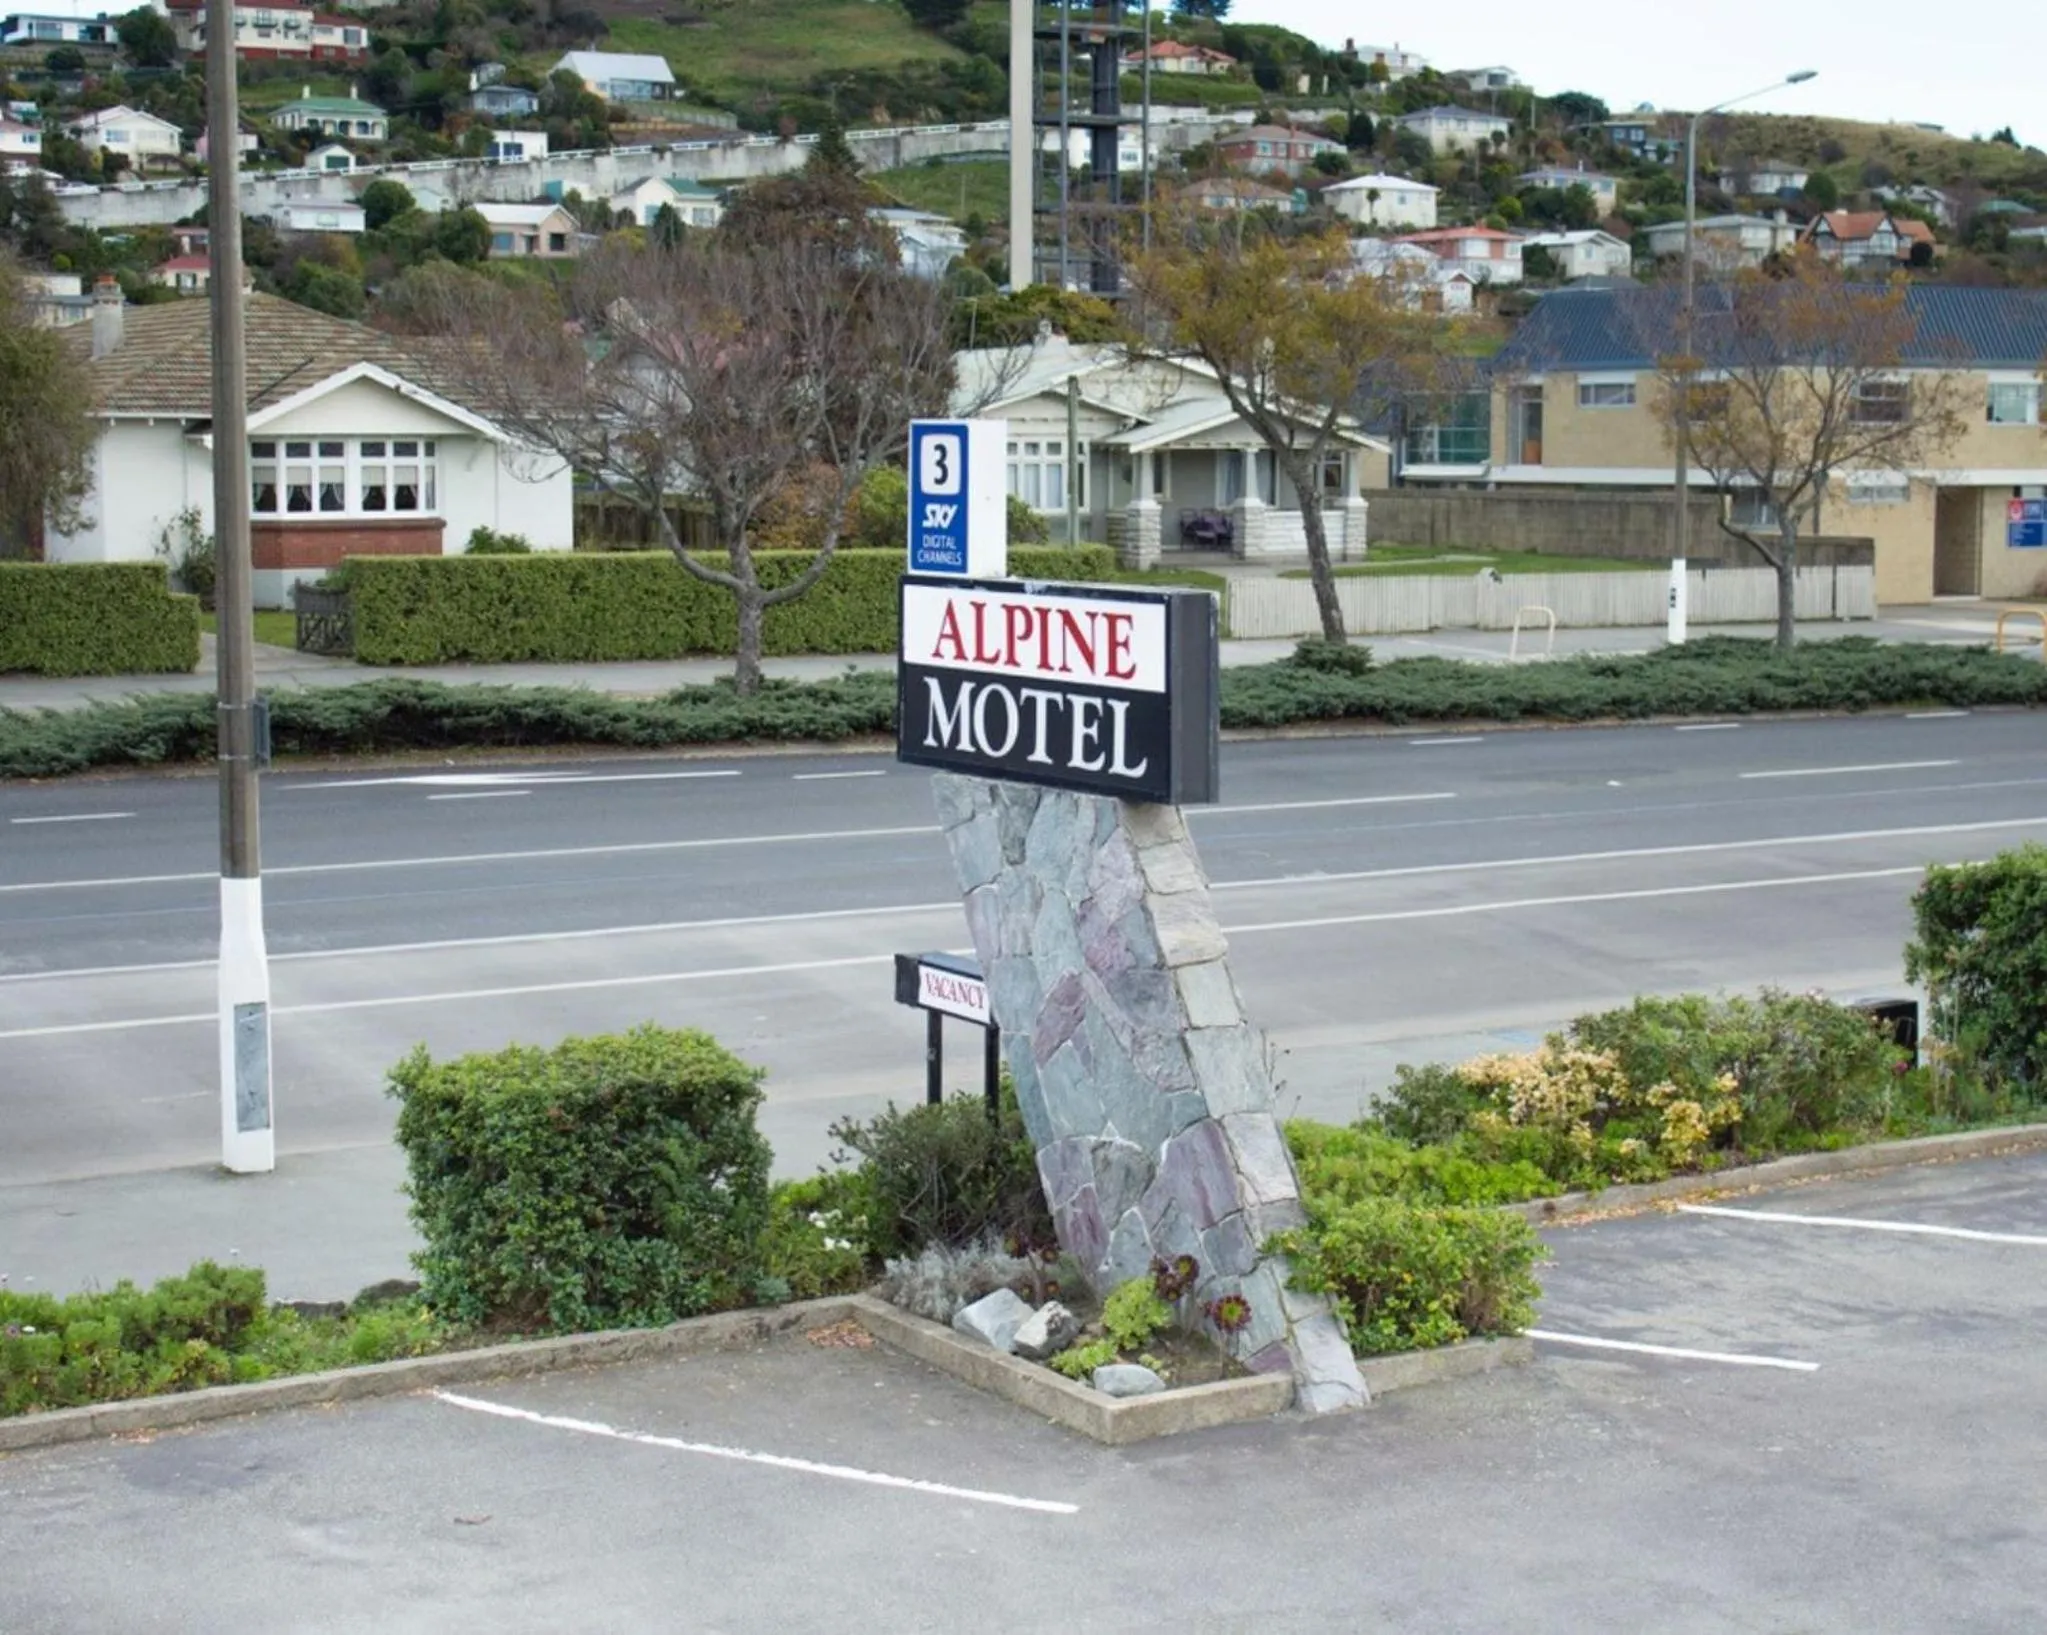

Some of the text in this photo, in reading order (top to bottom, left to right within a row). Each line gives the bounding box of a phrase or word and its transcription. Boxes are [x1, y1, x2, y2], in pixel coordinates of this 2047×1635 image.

[934, 444, 948, 485] 3
[922, 504, 958, 528] SKY
[916, 549, 962, 566] CHANNELS
[922, 534, 957, 550] DIGITAL
[933, 599, 1136, 680] ALPINE
[924, 677, 1147, 778] MOTEL
[926, 973, 985, 1008] VACANCY
